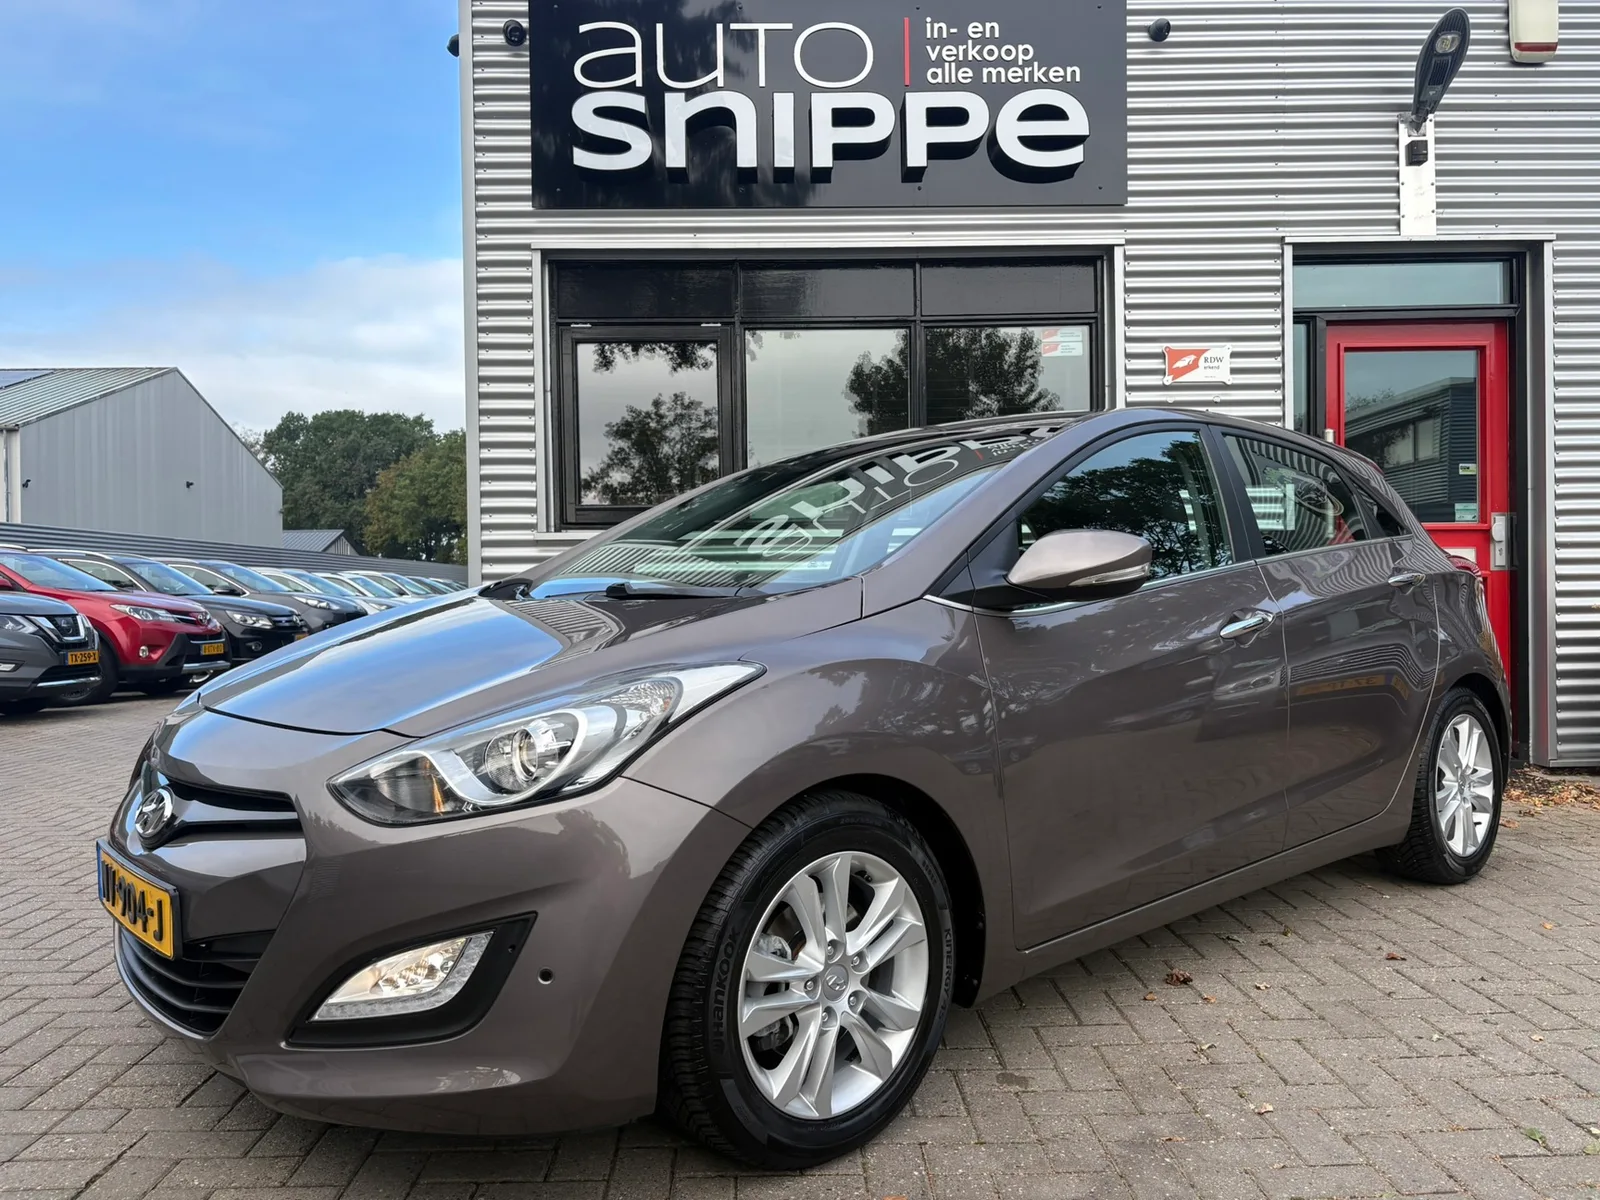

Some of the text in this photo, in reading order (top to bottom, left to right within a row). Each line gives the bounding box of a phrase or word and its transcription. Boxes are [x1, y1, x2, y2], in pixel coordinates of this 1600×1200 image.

[925, 16, 1000, 39] in- en
[926, 40, 1034, 65] verkoop
[926, 61, 1081, 84] alle merken
[70, 652, 97, 664] TX-259-X
